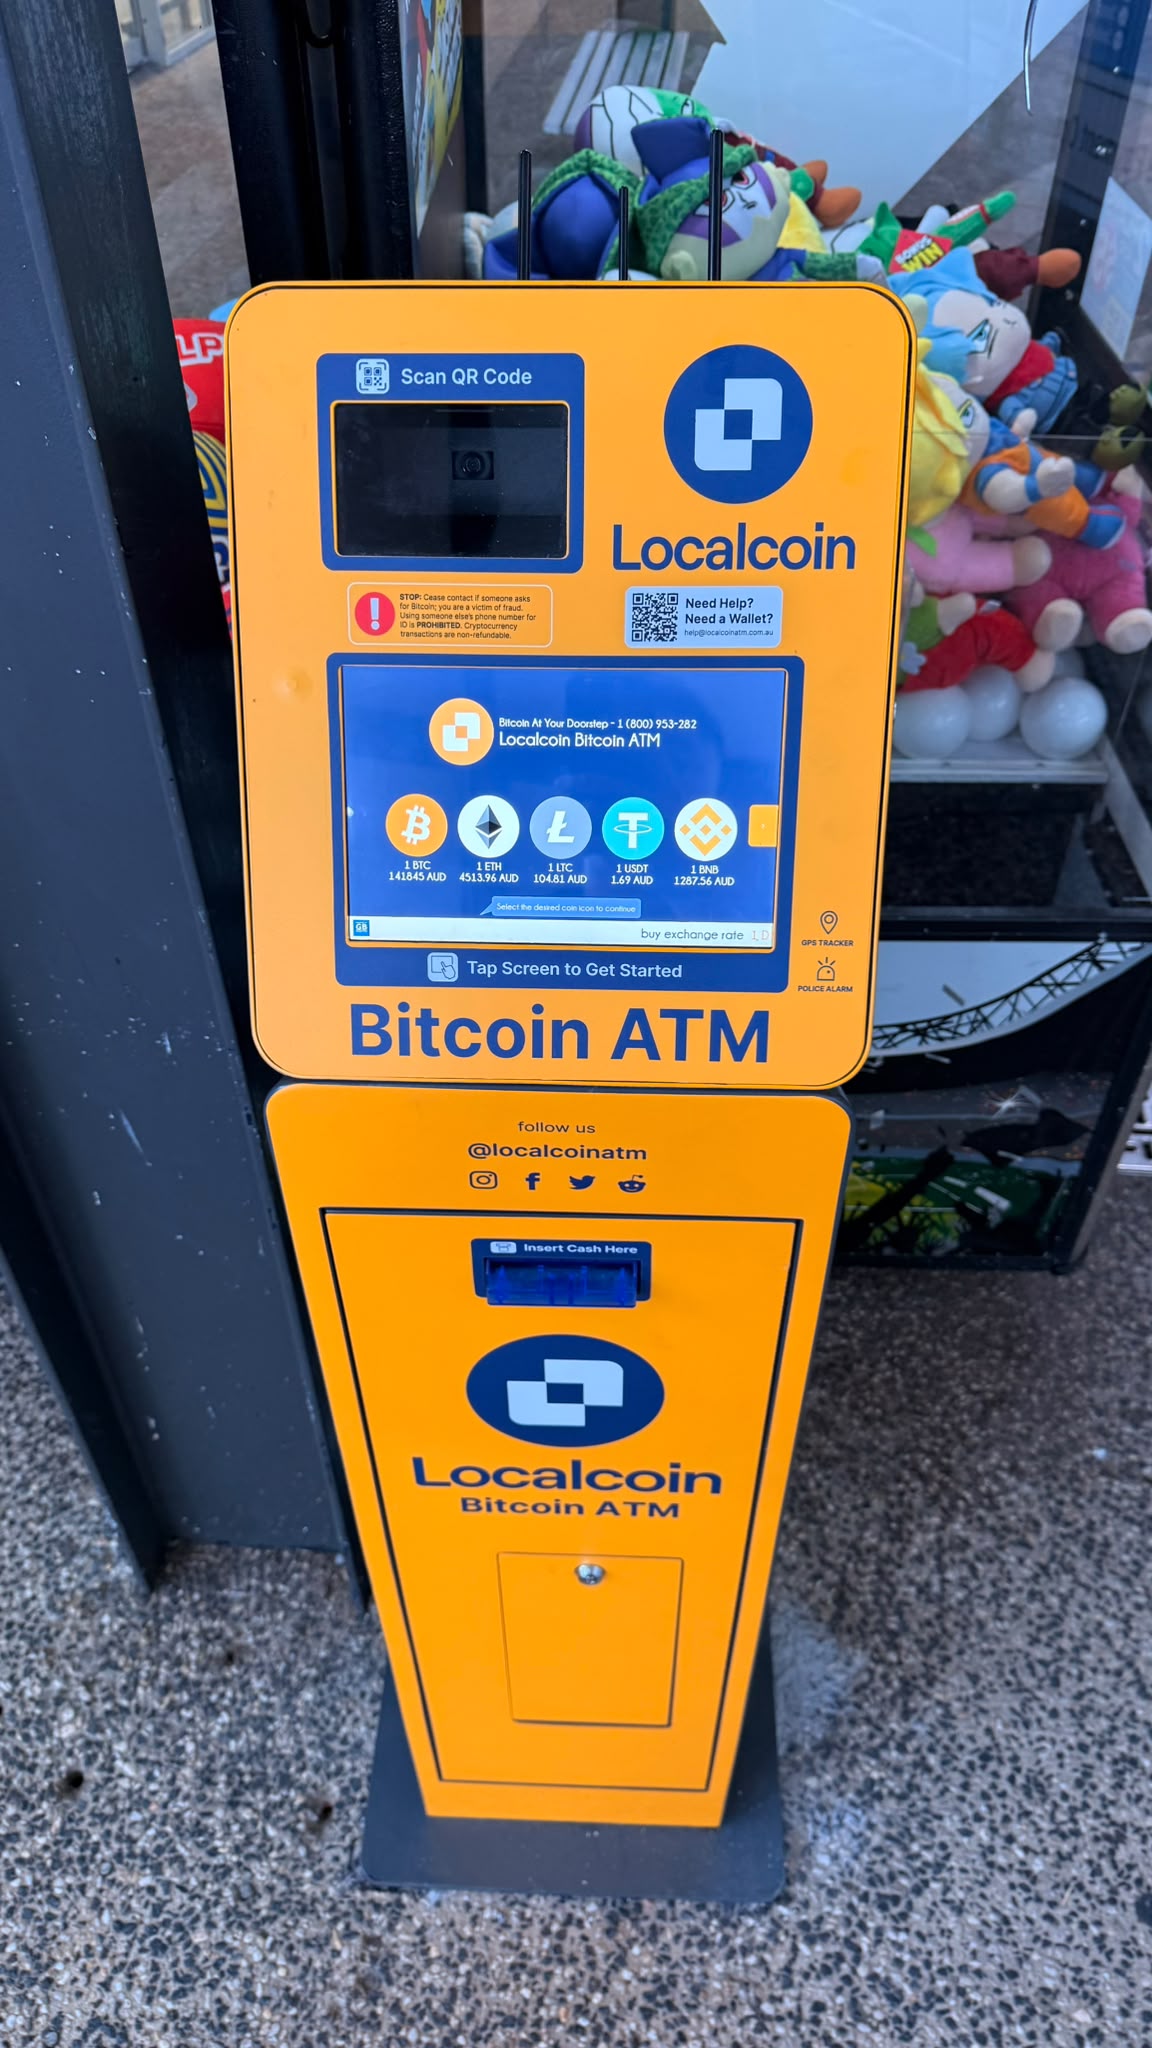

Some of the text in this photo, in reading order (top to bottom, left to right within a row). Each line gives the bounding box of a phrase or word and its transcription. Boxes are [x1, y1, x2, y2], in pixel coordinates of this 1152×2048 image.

[401, 368, 533, 386] Scan QR Code
[612, 522, 856, 571] Localcoin
[400, 593, 531, 603] STOP: Cease contact if someone asks
[400, 602, 410, 610] for
[438, 604, 451, 613] you
[472, 603, 493, 612] victim
[494, 603, 502, 612] of
[503, 603, 523, 612] fraud.
[685, 597, 754, 611] Need Help?
[400, 612, 420, 621] Using
[421, 613, 453, 621] someone
[474, 613, 497, 622] phone
[498, 613, 525, 621] number
[526, 613, 536, 621] for
[685, 613, 774, 624] Need a Wallet?
[400, 621, 518, 632] ID is PROHIBITED. Cryptocurrency
[400, 630, 442, 639] transactions
[456, 631, 512, 640] non-refundable.
[684, 629, 774, 638] help@localcoinatm.com.au
[499, 717, 530, 729] Bitcoin
[531, 718, 542, 729] At
[543, 718, 565, 729] Your
[567, 719, 609, 731] Doorstep
[617, 719, 623, 730] 1
[625, 718, 653, 731] (800)
[655, 719, 698, 730] 953-282
[499, 731, 661, 748] Localcoin Bitcoin ATM
[404, 860, 432, 870] 1 BTC
[476, 862, 502, 872] 1 ETH
[548, 863, 573, 873] 1 LTC
[616, 864, 649, 874] 1 USDT
[690, 865, 719, 875] 1 BNB
[388, 871, 447, 882] 141845 AUD
[459, 873, 519, 883] 4513.96 AUD
[533, 874, 588, 884] 104.81 AUD
[611, 875, 654, 885] 1.69 AUD
[674, 876, 735, 887] 1287.56 AUD
[496, 902, 520, 911] Select
[521, 903, 532, 911] the
[561, 904, 577, 912] coin
[578, 904, 594, 912] icon
[605, 905, 636, 913] continue
[641, 928, 661, 940] buy
[664, 928, 719, 941] exchange
[721, 930, 744, 940] rate
[818, 939, 854, 947] TRACKER
[467, 960, 683, 978] Tap Screen to Get Started
[826, 985, 854, 993] ALARM
[350, 1001, 770, 1063] Bitcoin ATM
[518, 1121, 596, 1134] follow us
[468, 1143, 647, 1160] @localcoinatm
[524, 1243, 638, 1254] Insert Cash Here
[412, 1456, 722, 1495] Localcoin
[461, 1496, 680, 1518] Bitcoin ATM
